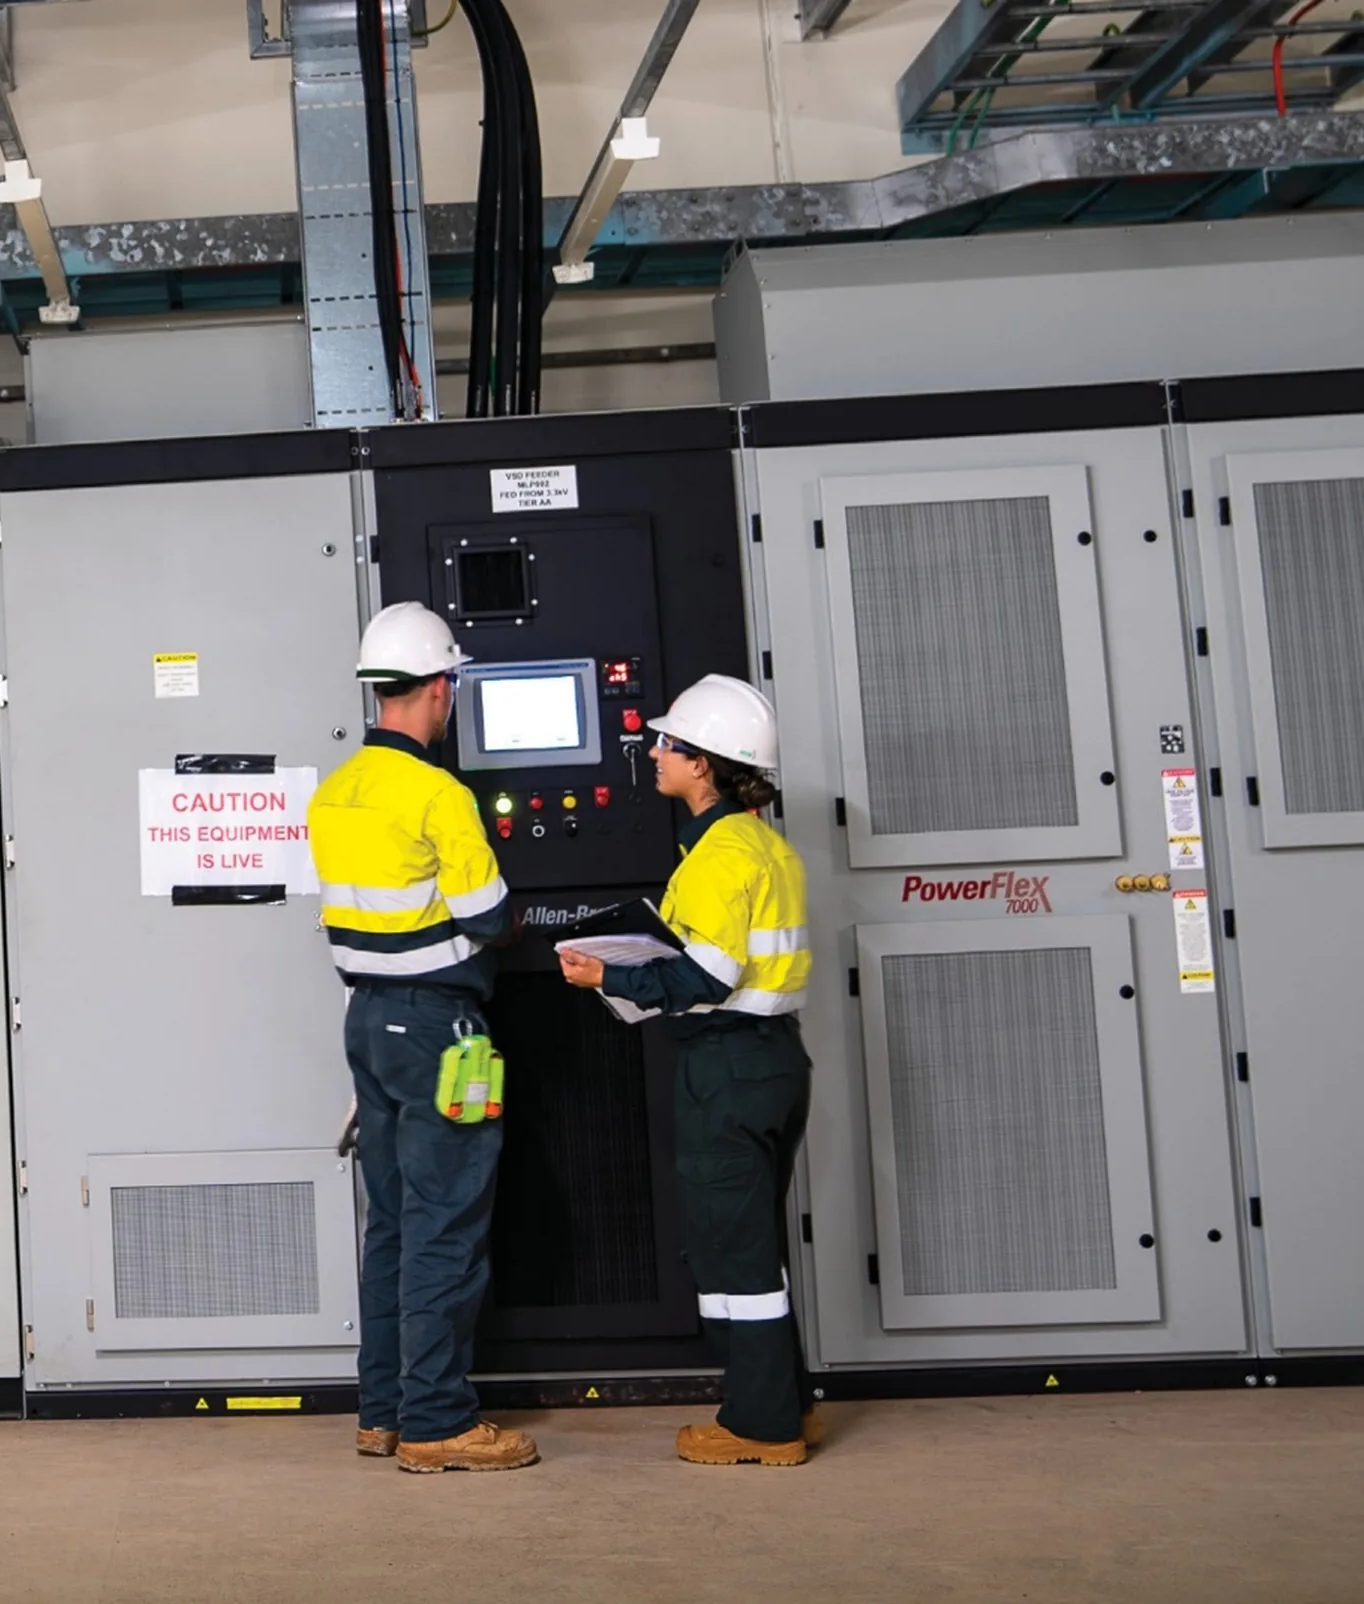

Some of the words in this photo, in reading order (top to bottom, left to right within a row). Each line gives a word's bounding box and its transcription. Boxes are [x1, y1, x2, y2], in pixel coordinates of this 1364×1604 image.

[505, 472, 523, 480] VSD
[525, 470, 559, 478] FEEDER
[500, 491, 517, 499] FED
[171, 792, 286, 812] CAUTION
[148, 826, 191, 842] THIS
[197, 825, 309, 842] EQUIPMENT
[197, 854, 214, 869] IS
[221, 853, 263, 868] LIVE
[901, 871, 1053, 914] PowerFlex
[1005, 899, 1038, 914] 7000
